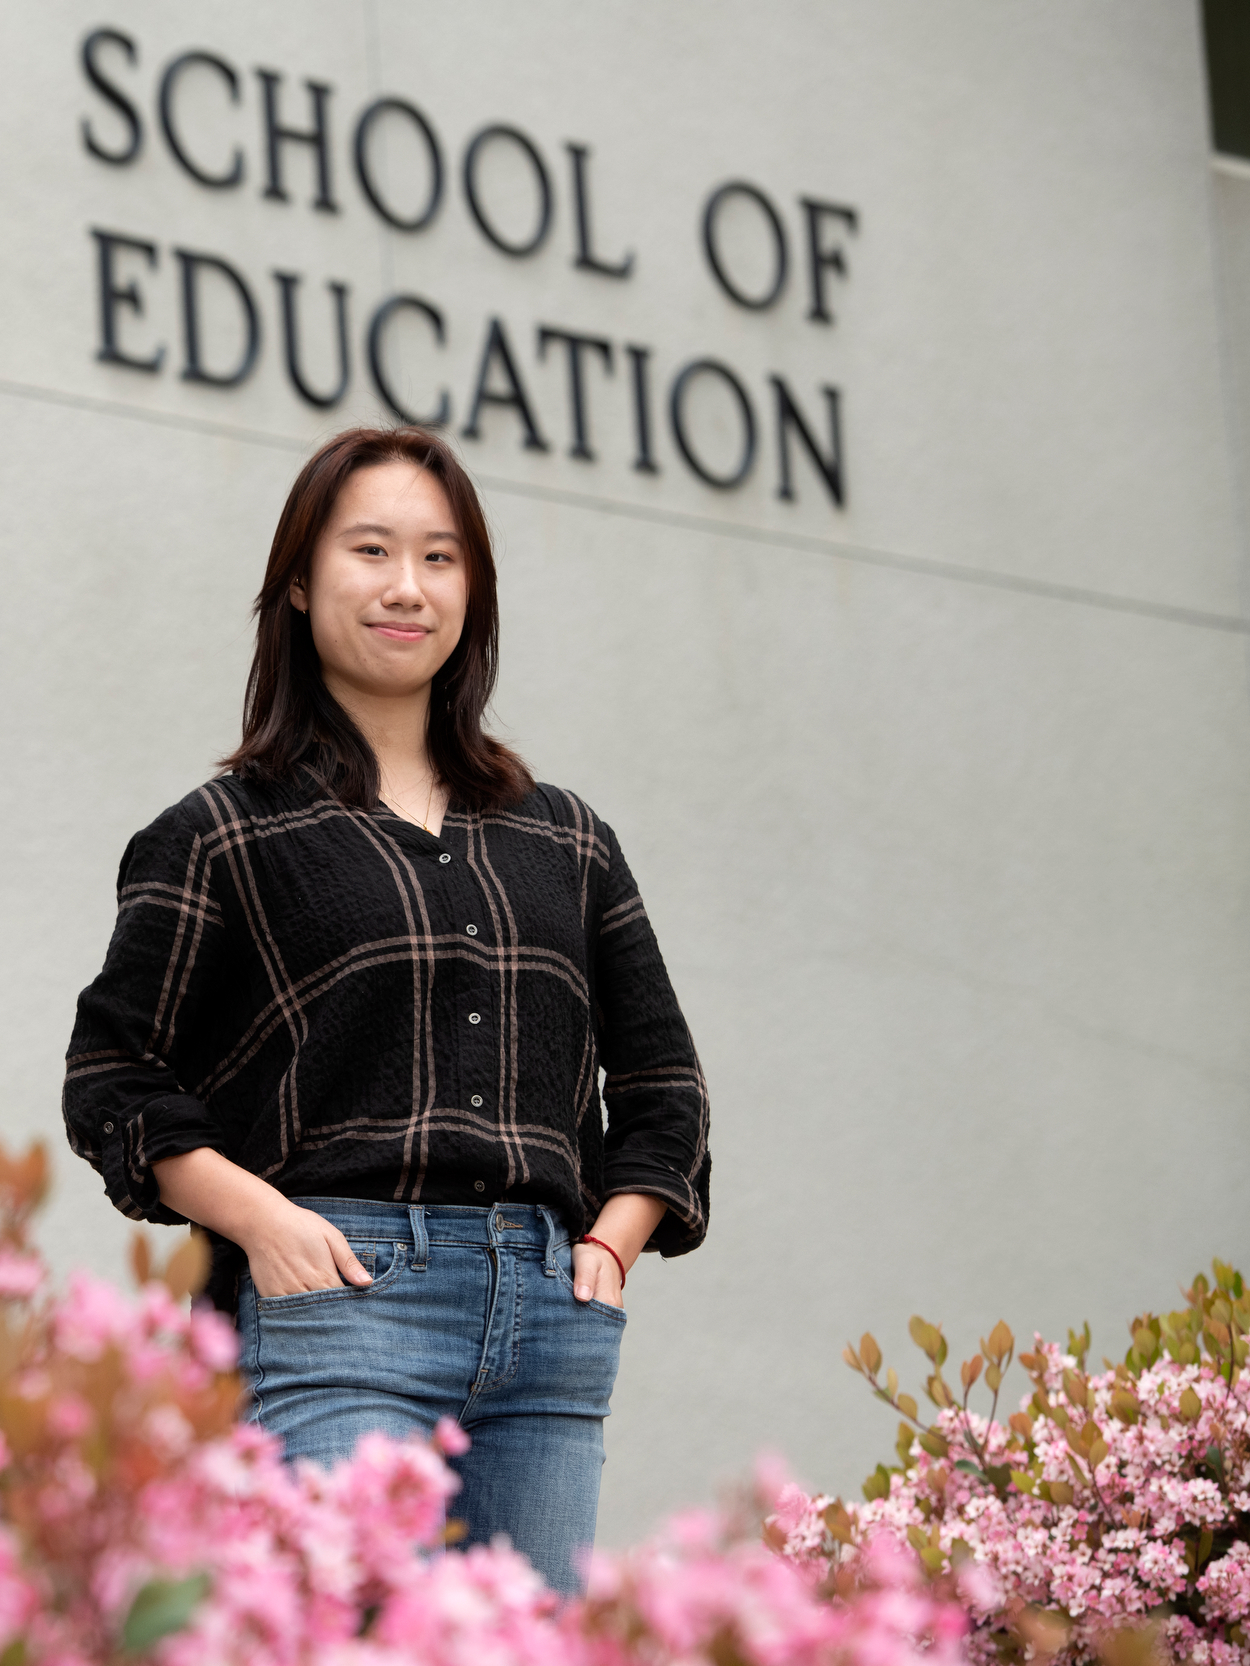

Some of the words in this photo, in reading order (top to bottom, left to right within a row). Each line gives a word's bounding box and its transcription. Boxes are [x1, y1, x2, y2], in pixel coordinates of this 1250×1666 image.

[80, 26, 634, 282] SCHOOL
[701, 180, 859, 327] OF
[89, 227, 848, 511] EDUCATION
